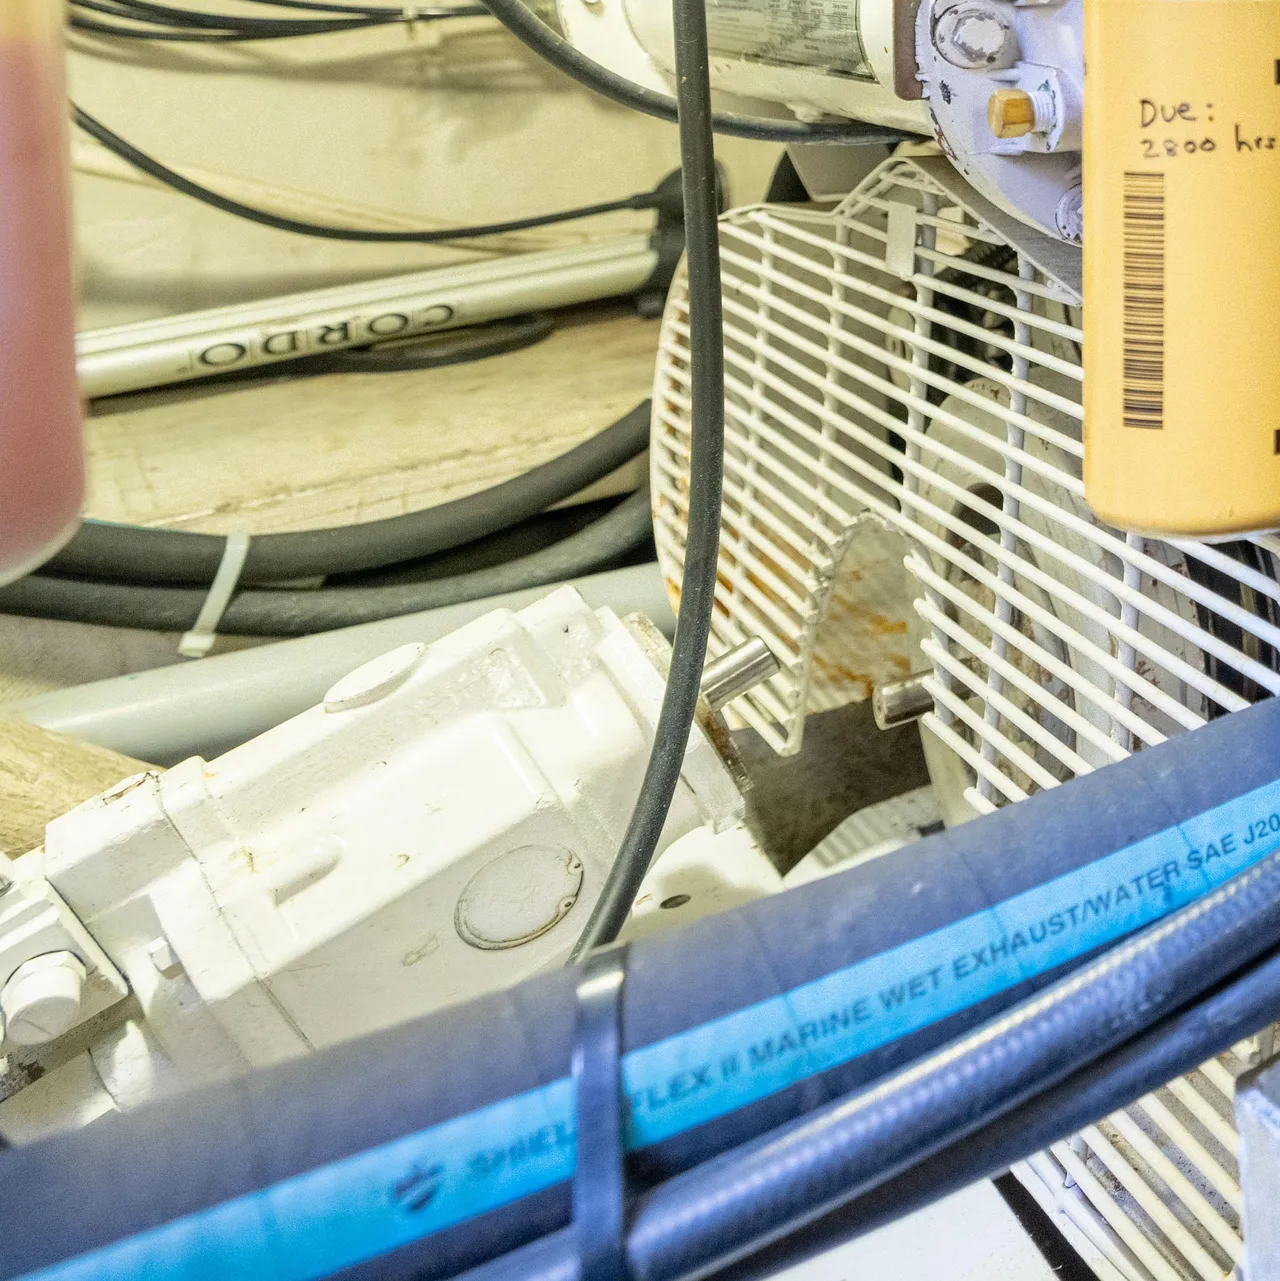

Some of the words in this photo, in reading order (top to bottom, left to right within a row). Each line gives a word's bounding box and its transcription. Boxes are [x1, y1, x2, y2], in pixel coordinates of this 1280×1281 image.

[1140, 136, 1216, 158] 2800
[747, 1004, 874, 1075] MARINE
[877, 967, 945, 1012] WET
[952, 858, 1184, 981] EXHAUST/WATER
[1185, 830, 1239, 872] SAE
